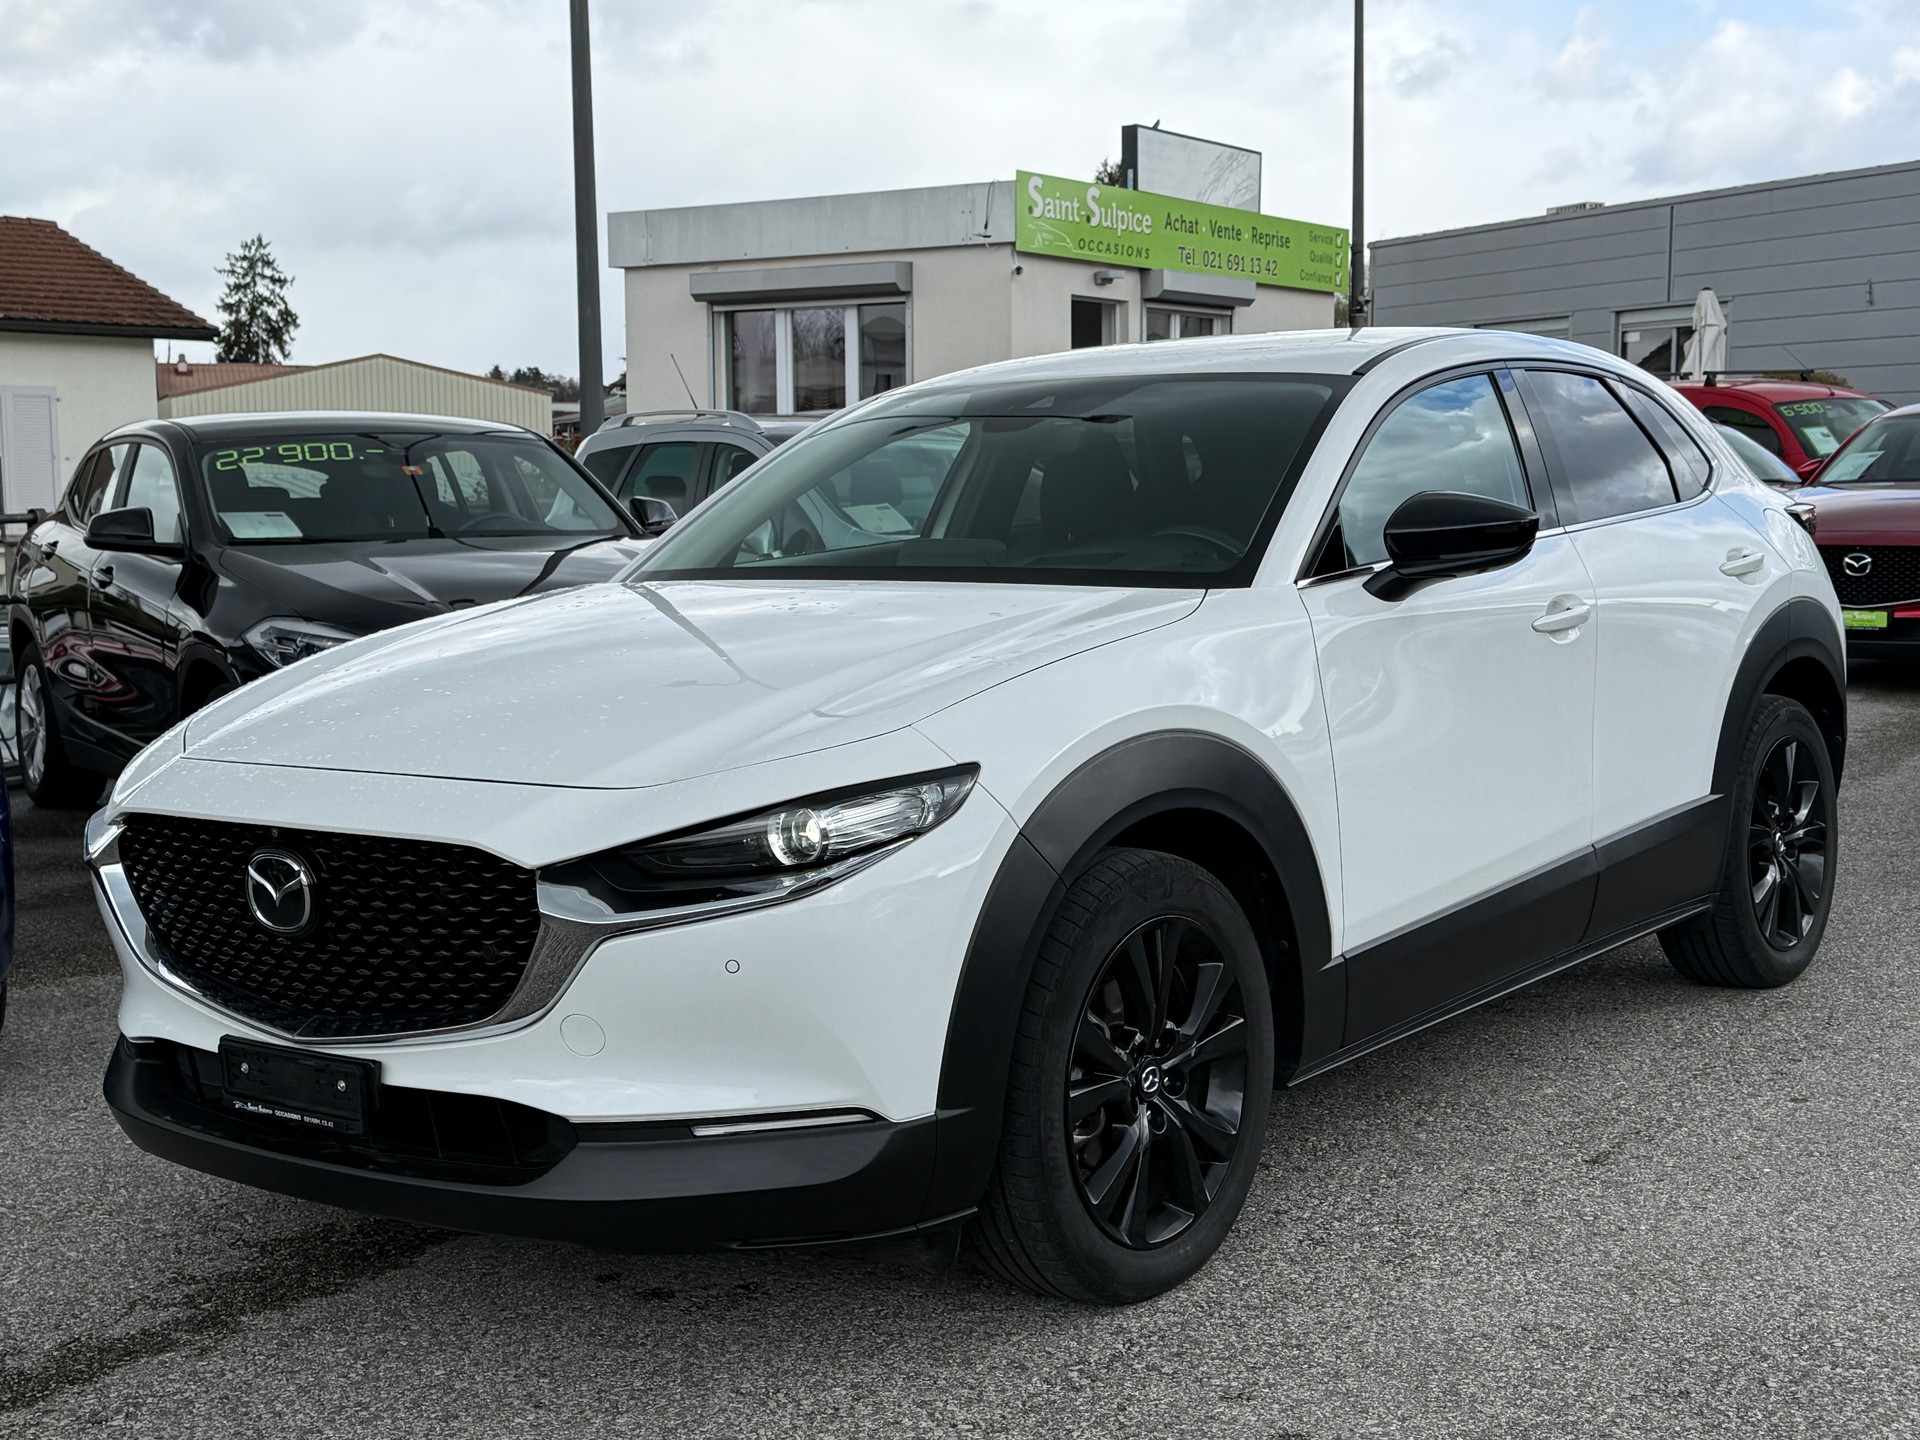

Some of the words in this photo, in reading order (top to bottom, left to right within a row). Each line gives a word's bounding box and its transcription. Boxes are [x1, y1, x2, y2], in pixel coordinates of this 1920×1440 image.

[1027, 176, 1152, 236] Saint-Sulpice
[1164, 211, 1199, 235] Achat
[1209, 219, 1242, 242] Vente
[1251, 226, 1291, 250] Reprise
[1078, 238, 1150, 260] OCCASIONS
[1203, 250, 1223, 270] 021
[1226, 253, 1246, 273] 691
[1249, 257, 1262, 275] 13
[1265, 259, 1278, 277] 42
